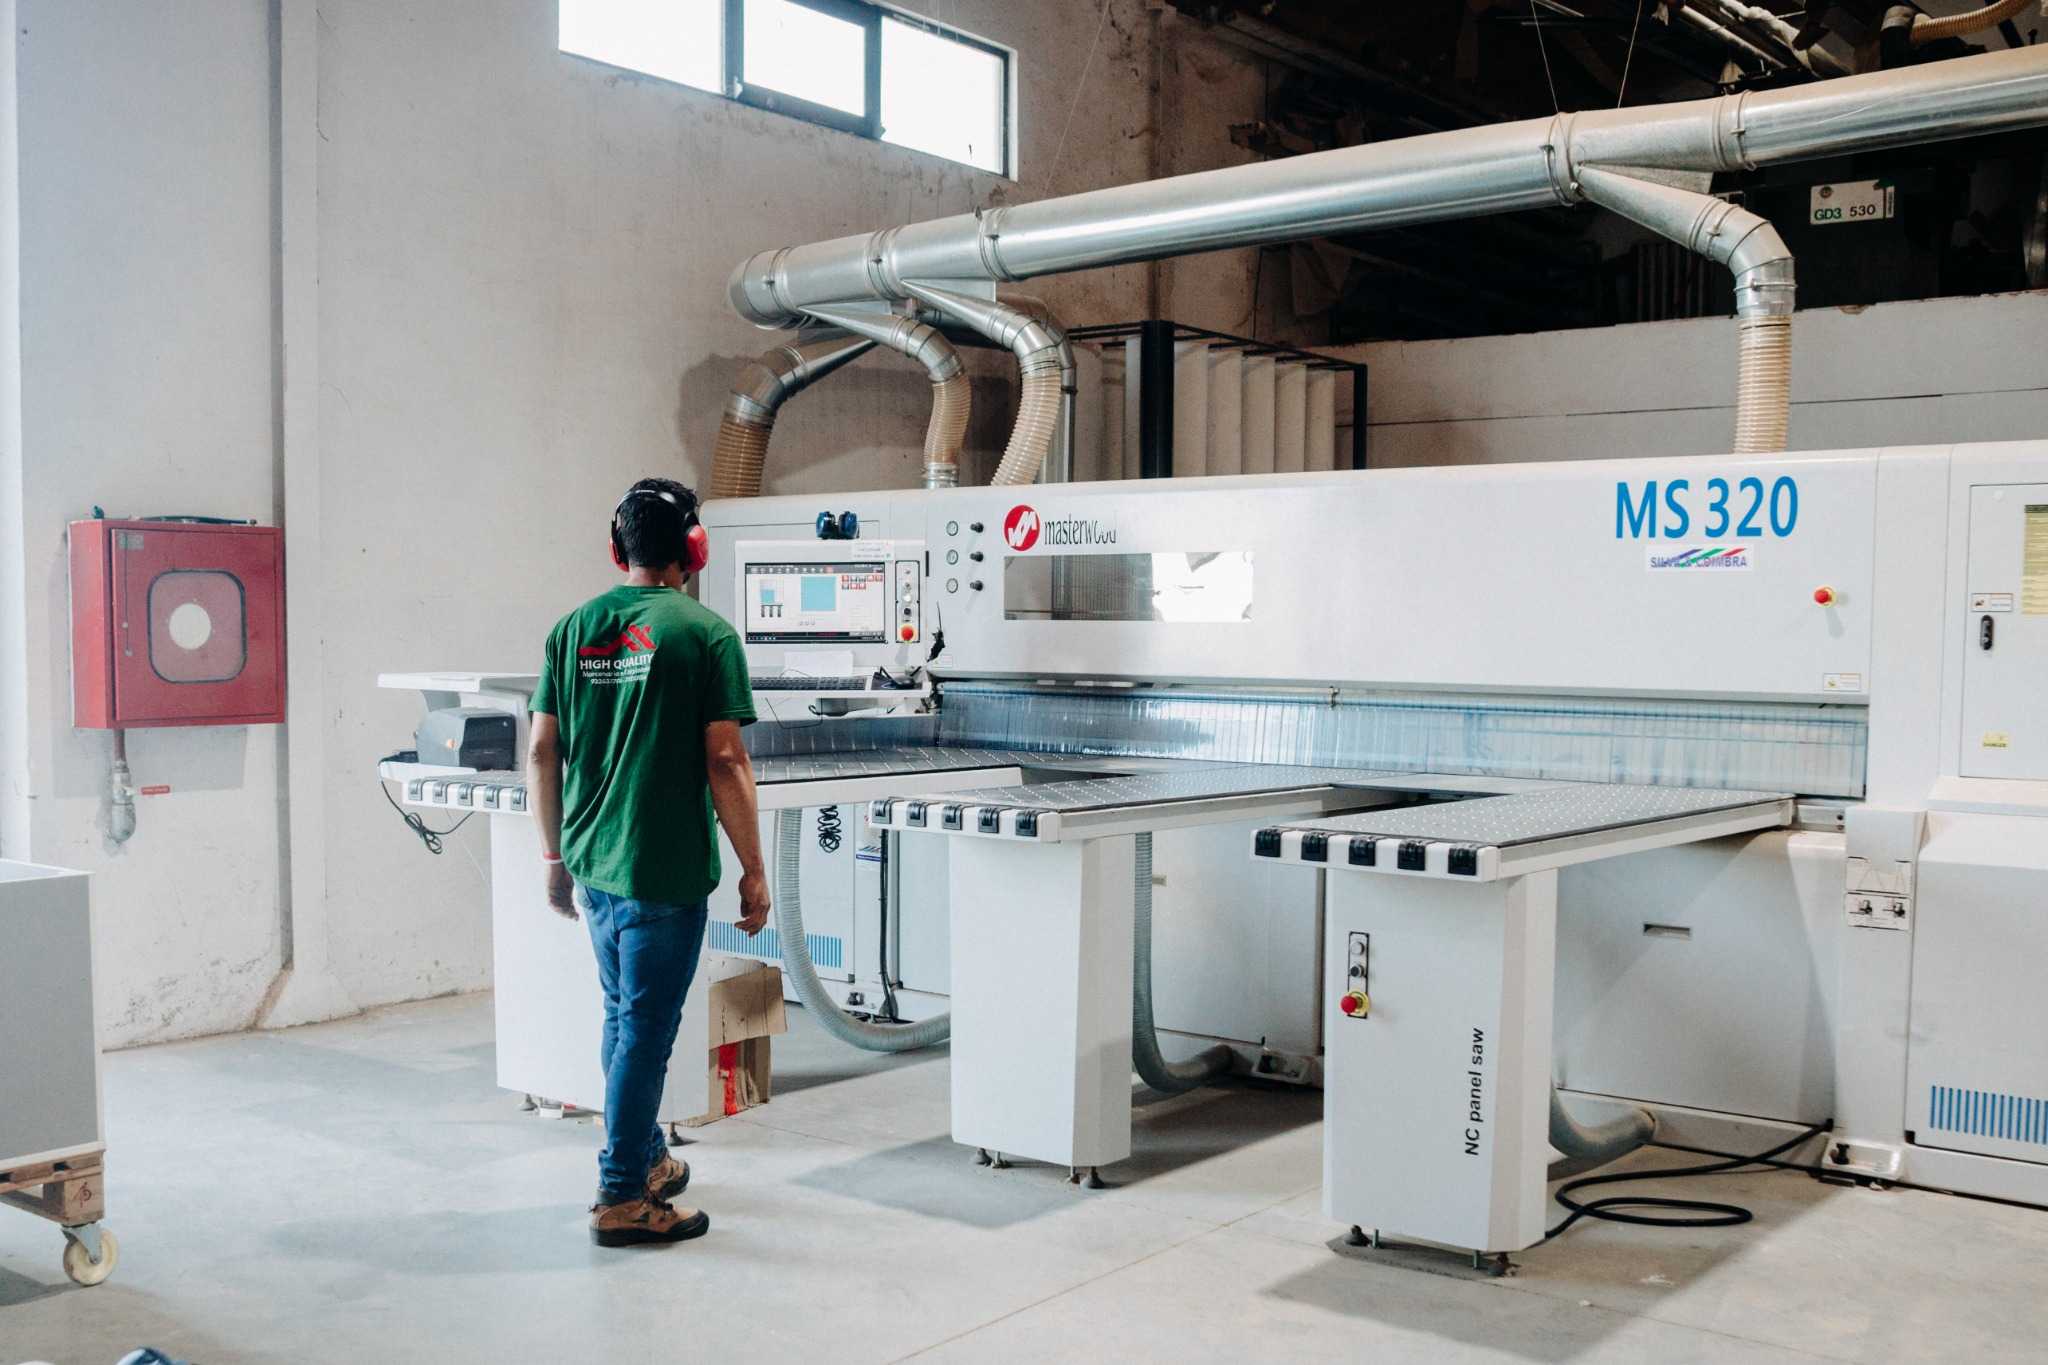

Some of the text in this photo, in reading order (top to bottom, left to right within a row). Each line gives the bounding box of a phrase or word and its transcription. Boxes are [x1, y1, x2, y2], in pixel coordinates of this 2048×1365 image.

[1814, 204, 1876, 221] GD3 530
[1616, 476, 1798, 539] MS 320
[580, 653, 654, 670] HIGH QUALITY
[1465, 1028, 1484, 1155] NC panel saw
